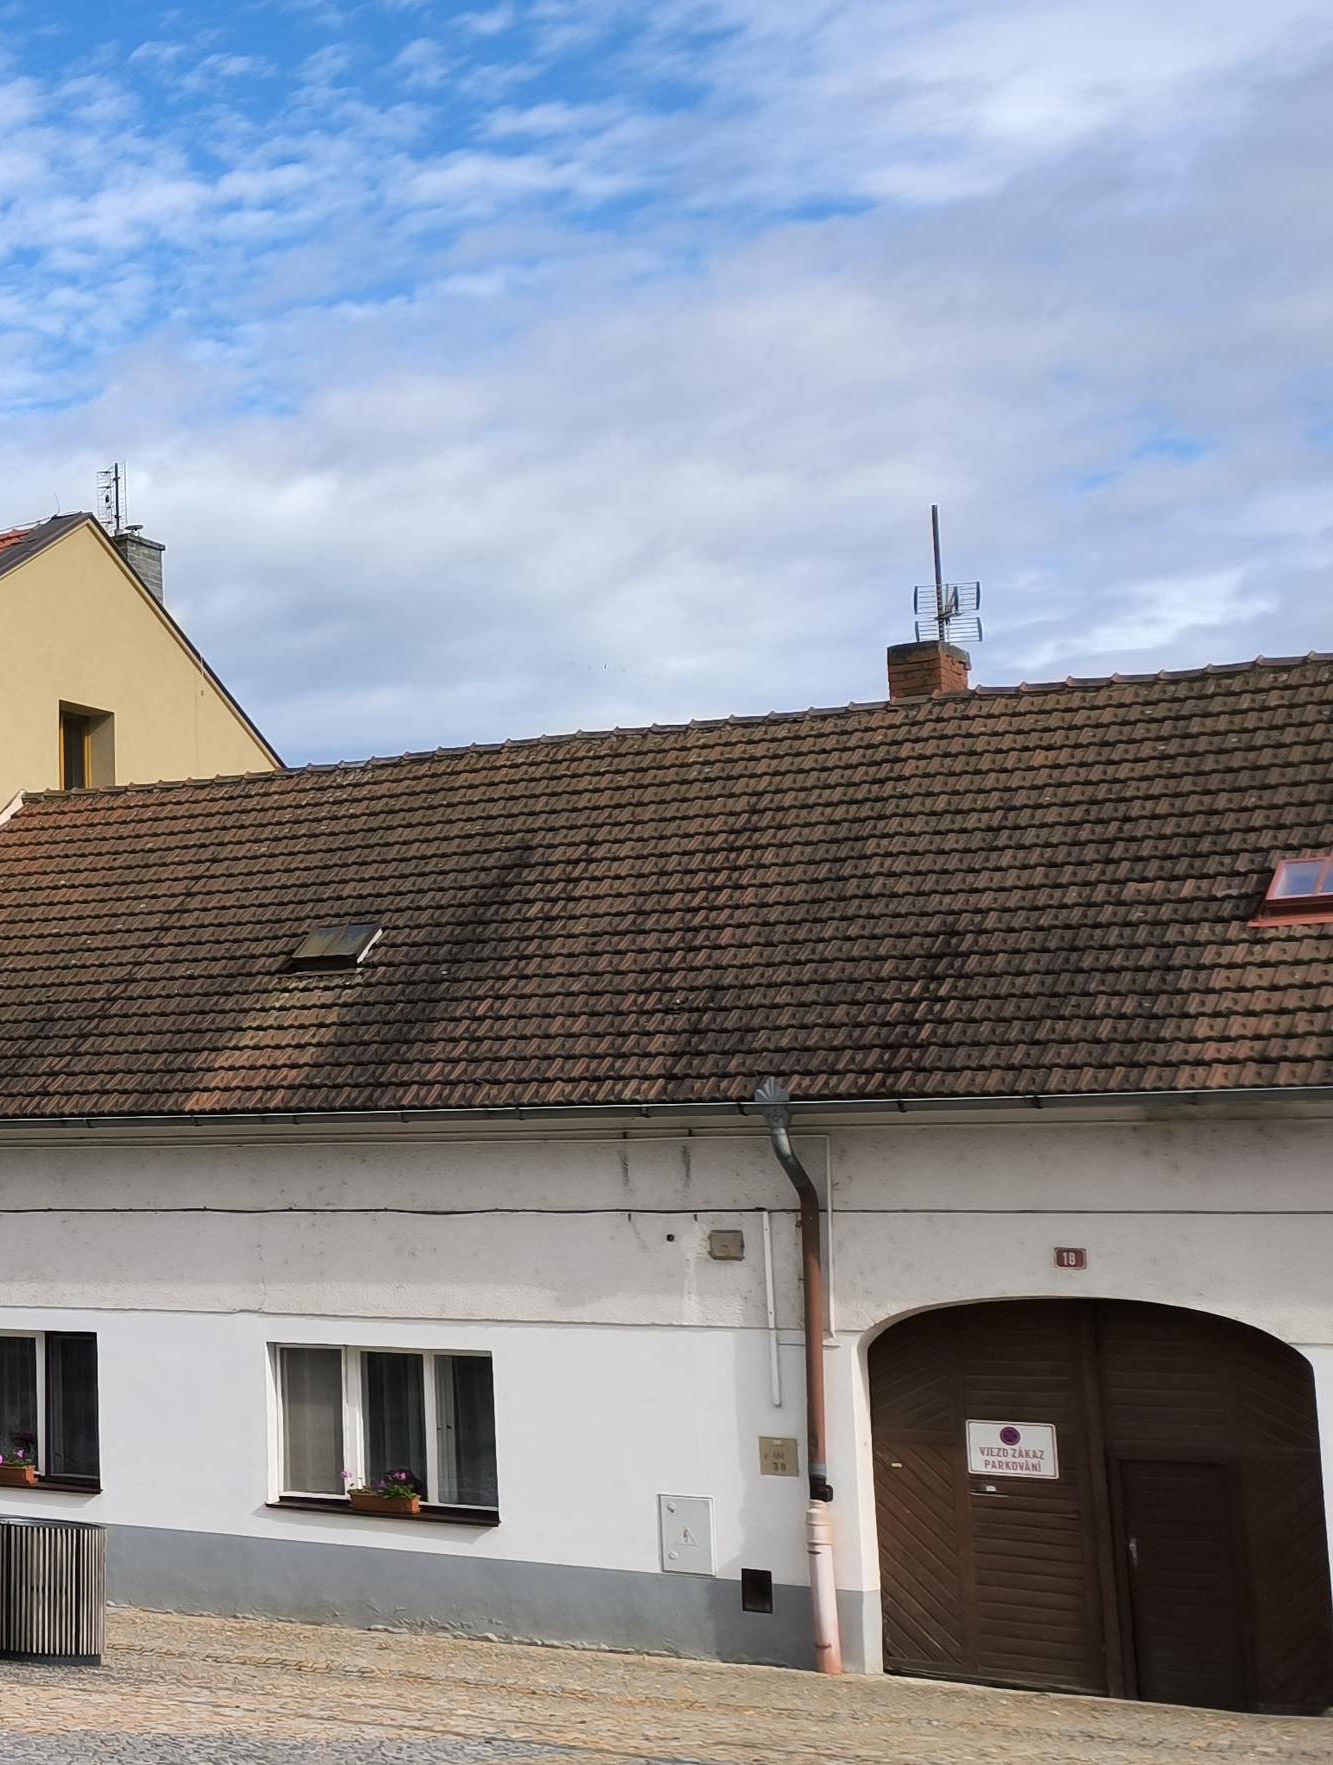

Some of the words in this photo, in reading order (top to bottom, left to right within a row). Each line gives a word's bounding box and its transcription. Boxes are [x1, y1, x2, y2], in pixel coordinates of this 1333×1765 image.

[1063, 1251, 1076, 1266] 18
[979, 1446, 1009, 1458] VJEZD
[1011, 1446, 1045, 1460] ZÁKAZ
[984, 1460, 1042, 1473] PARKOVÁNÍ
